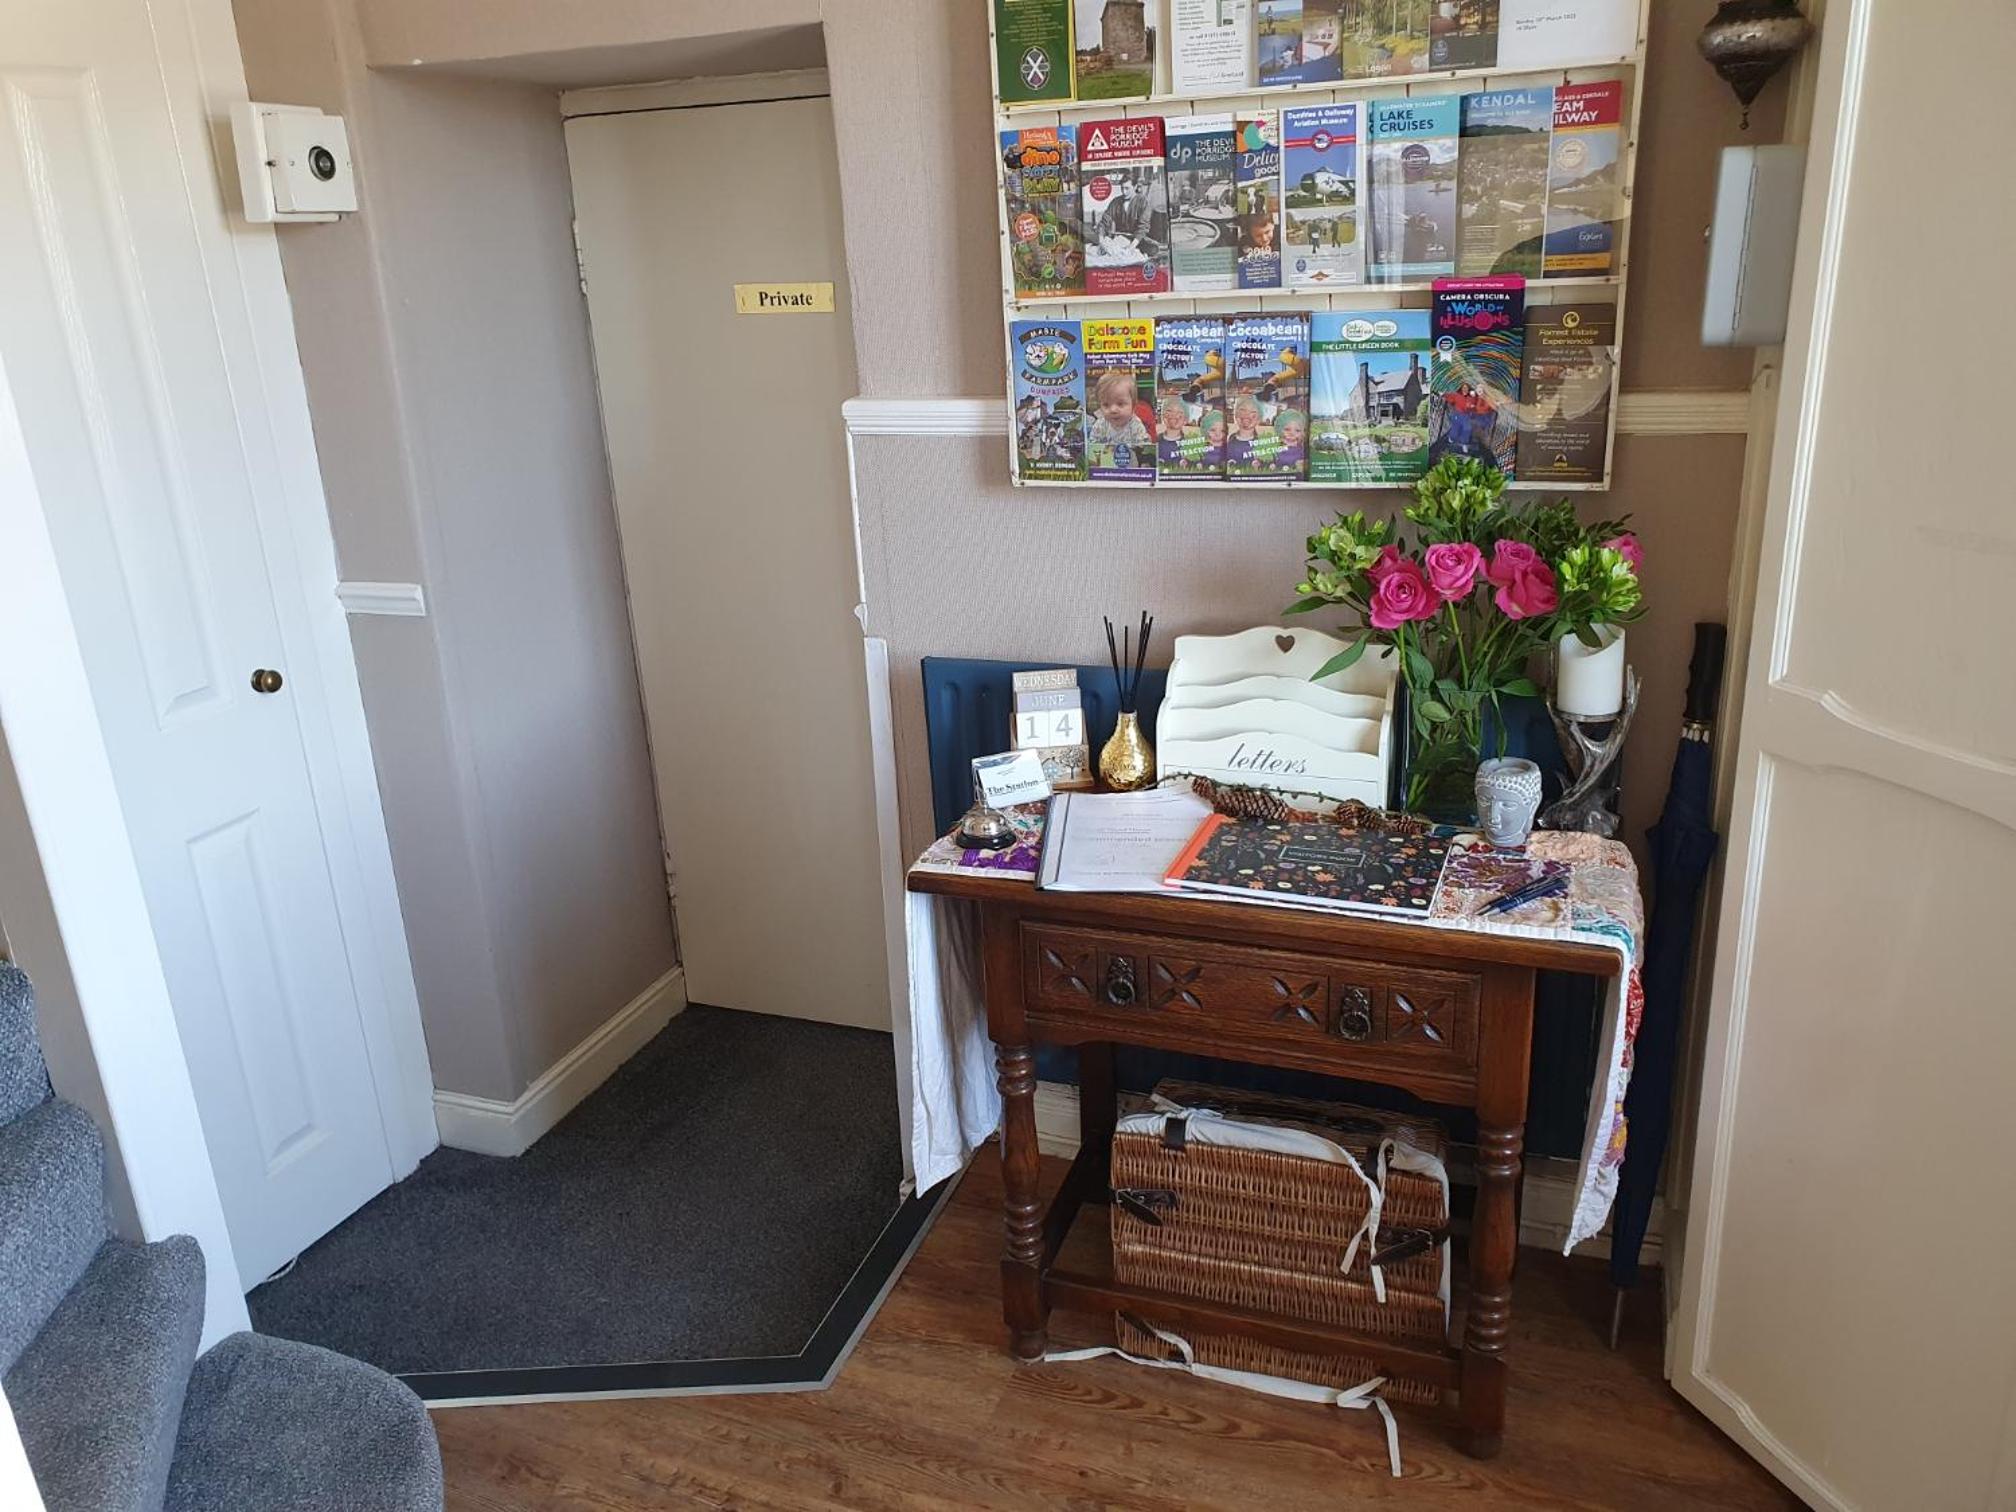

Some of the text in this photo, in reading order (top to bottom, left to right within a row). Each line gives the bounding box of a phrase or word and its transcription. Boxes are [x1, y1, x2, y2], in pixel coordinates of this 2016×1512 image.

[1470, 93, 1536, 109] KENDAL
[1554, 101, 1583, 113] EAM
[1380, 110, 1413, 121] LAKE
[1554, 111, 1598, 124] ILWAY
[1110, 126, 1125, 134] THE
[1293, 120, 1319, 128] Aviation
[1380, 120, 1434, 132] CRUISES
[1195, 139, 1210, 148] THE
[759, 291, 813, 307] Private
[1155, 324, 1224, 338] Cocoabean
[1228, 322, 1302, 337] Cocoabean
[1088, 337, 1147, 350] Farm Fun
[1170, 445, 1215, 458] ATTRACTION
[1242, 446, 1289, 459] ATTRACTION
[1014, 673, 1076, 687] WEDNESDAY
[1031, 694, 1065, 707] JUNE
[1228, 743, 1306, 774] letters
[986, 785, 1004, 795] The
